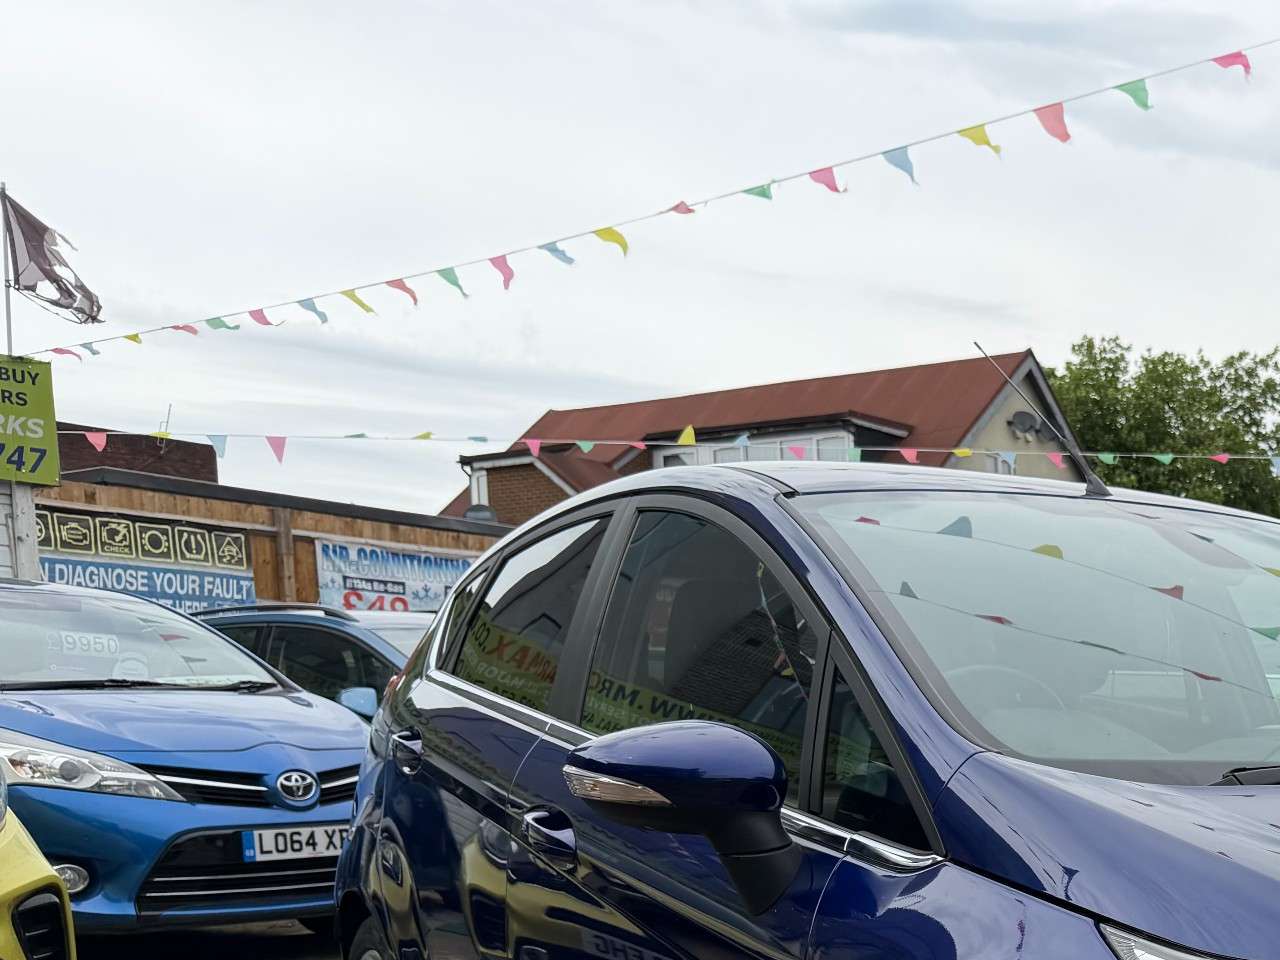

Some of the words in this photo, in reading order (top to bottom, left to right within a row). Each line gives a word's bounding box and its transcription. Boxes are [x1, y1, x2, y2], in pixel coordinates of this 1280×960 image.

[0, 366, 40, 386] BUY
[0, 389, 28, 407] RS
[55, 563, 148, 591] DIAGNOSE
[152, 571, 200, 595] YOUR
[258, 830, 318, 855] LO64
